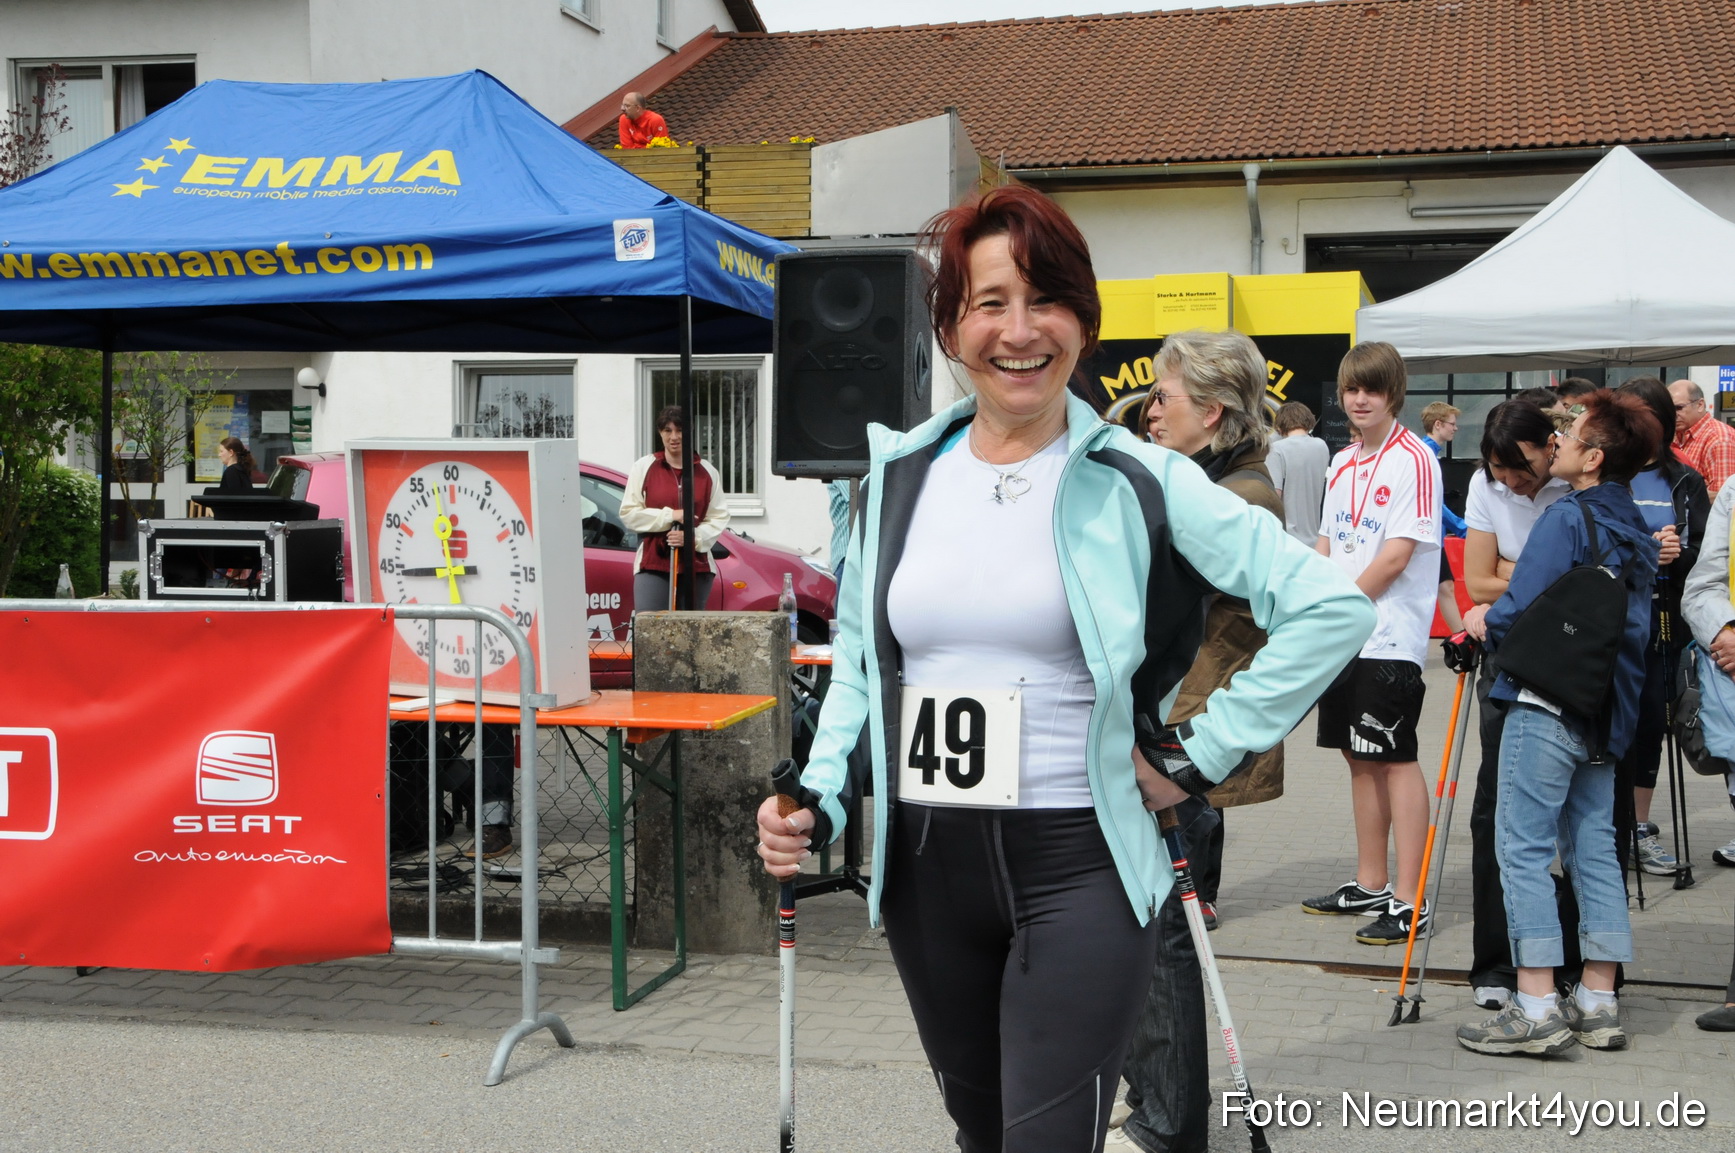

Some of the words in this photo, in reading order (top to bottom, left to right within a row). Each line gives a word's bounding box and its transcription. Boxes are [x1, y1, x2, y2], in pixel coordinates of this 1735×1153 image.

[180, 150, 461, 188] EMMA
[173, 186, 251, 199] european
[254, 189, 309, 201] mobile
[312, 187, 364, 198] media
[368, 184, 458, 197] association
[0, 241, 434, 279] w.emmanet.com
[443, 465, 460, 481] 60
[409, 478, 425, 493] 55
[484, 481, 492, 497] 5
[385, 513, 401, 528] 50
[511, 520, 525, 536] 10
[1361, 516, 1382, 534] ady
[380, 559, 394, 573] 45
[522, 567, 536, 583] 15
[515, 611, 532, 628] 20
[416, 642, 430, 658] 35
[489, 650, 505, 666] 25
[453, 659, 470, 675] 30
[908, 697, 986, 789] 49
[173, 815, 302, 834] SEAT
[1222, 1027, 1240, 1065] Hiking
